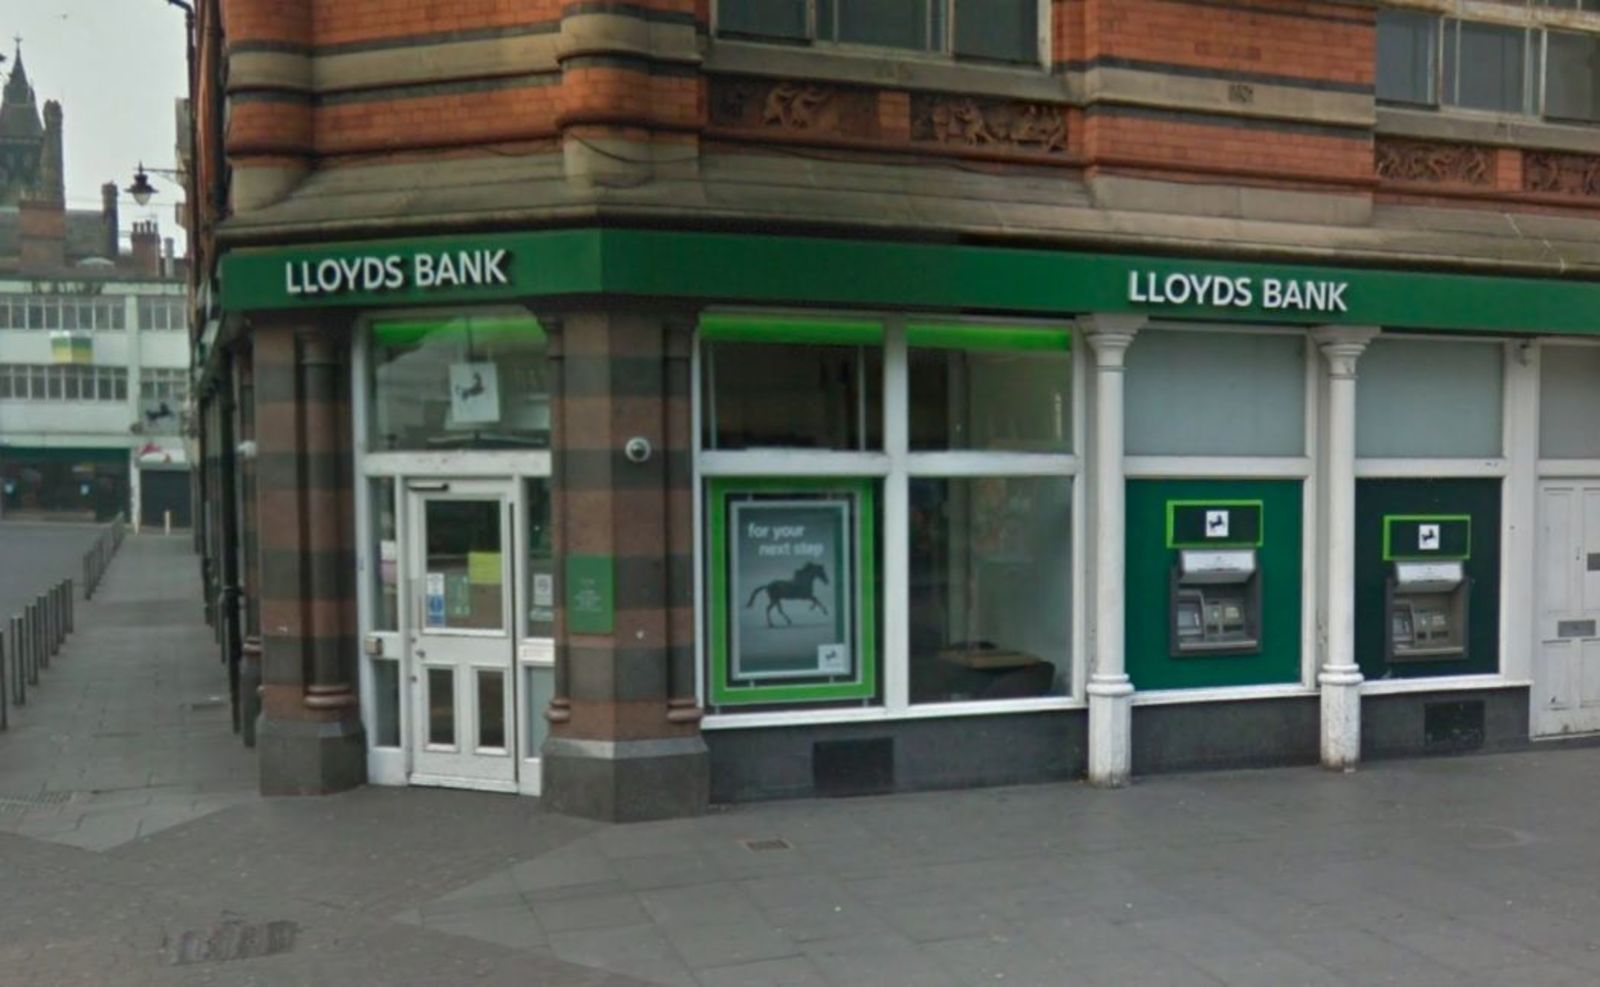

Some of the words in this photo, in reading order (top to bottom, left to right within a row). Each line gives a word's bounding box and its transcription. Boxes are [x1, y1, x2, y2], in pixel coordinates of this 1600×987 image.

[286, 255, 404, 293] LLOYDS
[415, 250, 507, 286] BANK
[1129, 270, 1252, 306] LLOYDS
[1263, 278, 1348, 311] BANK
[748, 522, 768, 538] for
[772, 525, 805, 541] your
[759, 542, 790, 556] next
[793, 542, 823, 557] step
